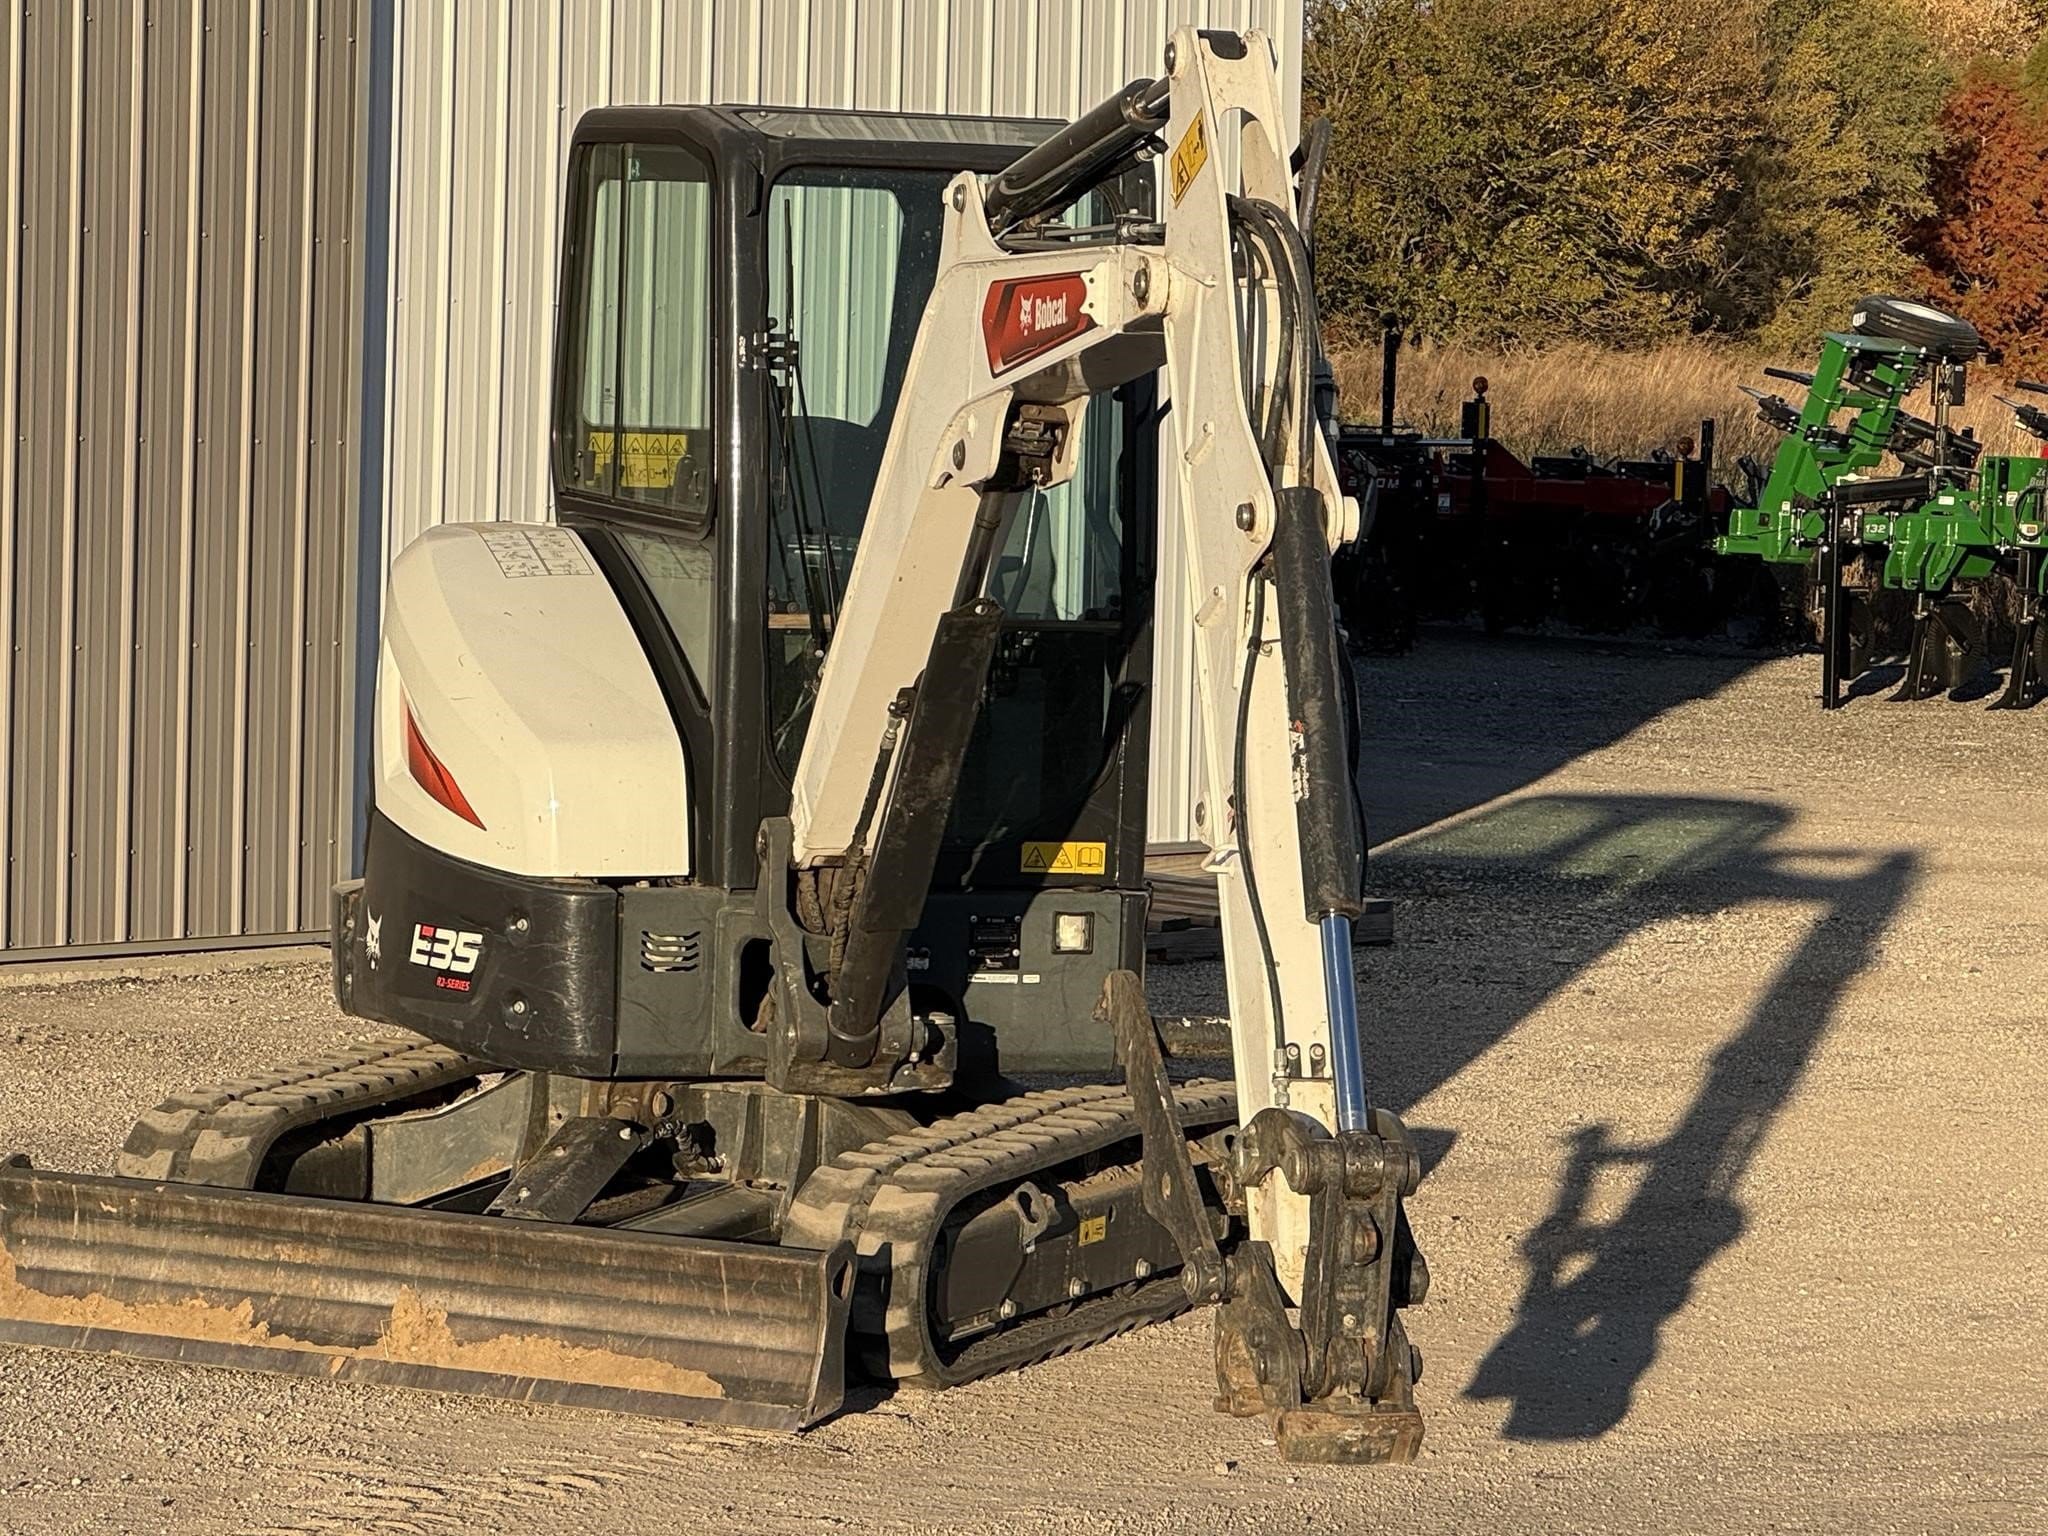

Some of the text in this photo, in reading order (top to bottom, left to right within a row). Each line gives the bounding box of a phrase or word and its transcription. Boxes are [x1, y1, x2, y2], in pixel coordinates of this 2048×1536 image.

[1035, 292, 1067, 331] Bobcat
[1865, 523, 1886, 533] 132
[410, 923, 483, 973] E35
[436, 976, 471, 991] R2-SERIES
